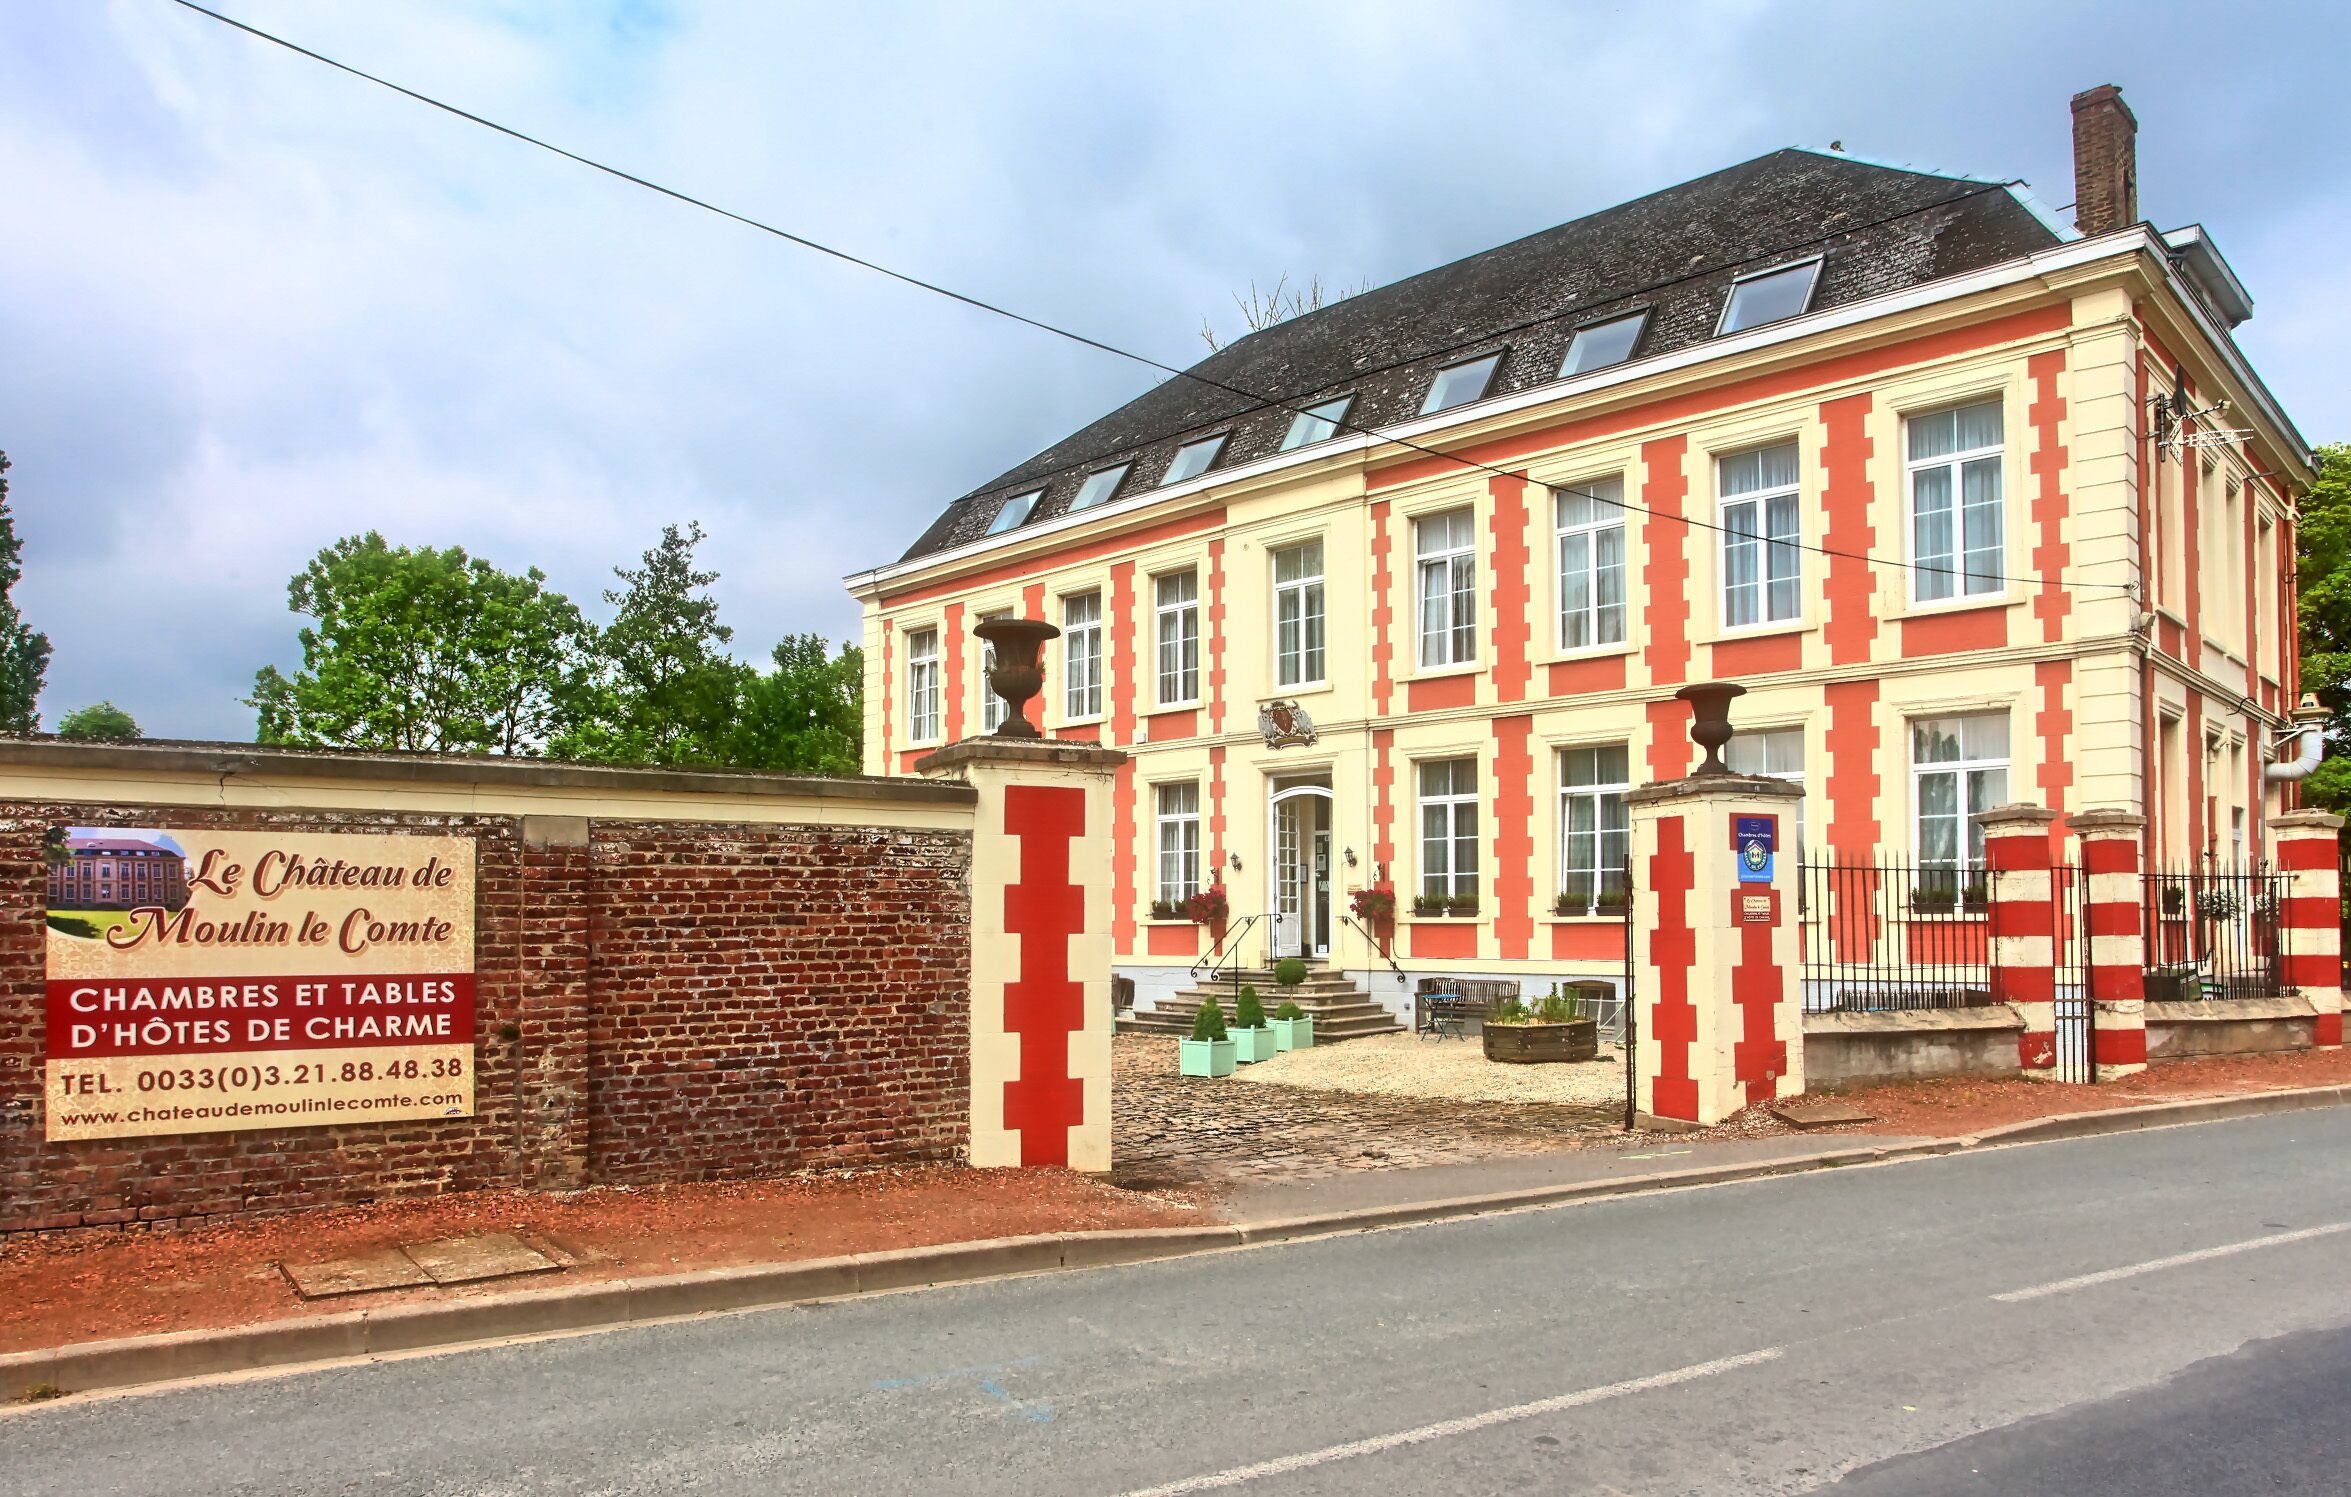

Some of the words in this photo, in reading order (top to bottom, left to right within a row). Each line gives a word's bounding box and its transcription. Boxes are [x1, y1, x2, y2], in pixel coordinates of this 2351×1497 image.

[187, 849, 242, 895] Le
[253, 850, 405, 897] Château
[412, 857, 452, 887] de
[106, 907, 290, 949] Moulin
[297, 911, 329, 943] le
[339, 908, 452, 953] Comte
[70, 984, 279, 1012] CHAMBRES
[296, 984, 328, 1006] ET
[341, 981, 455, 1005] TABLES
[247, 1018, 290, 1042] DE
[305, 1014, 451, 1040] CHARME
[61, 1073, 123, 1095] TEL.
[138, 1058, 462, 1092] 0033(0)3.21.88.48.38
[61, 1093, 462, 1126] www.chateaudemoulinlecomte.com
